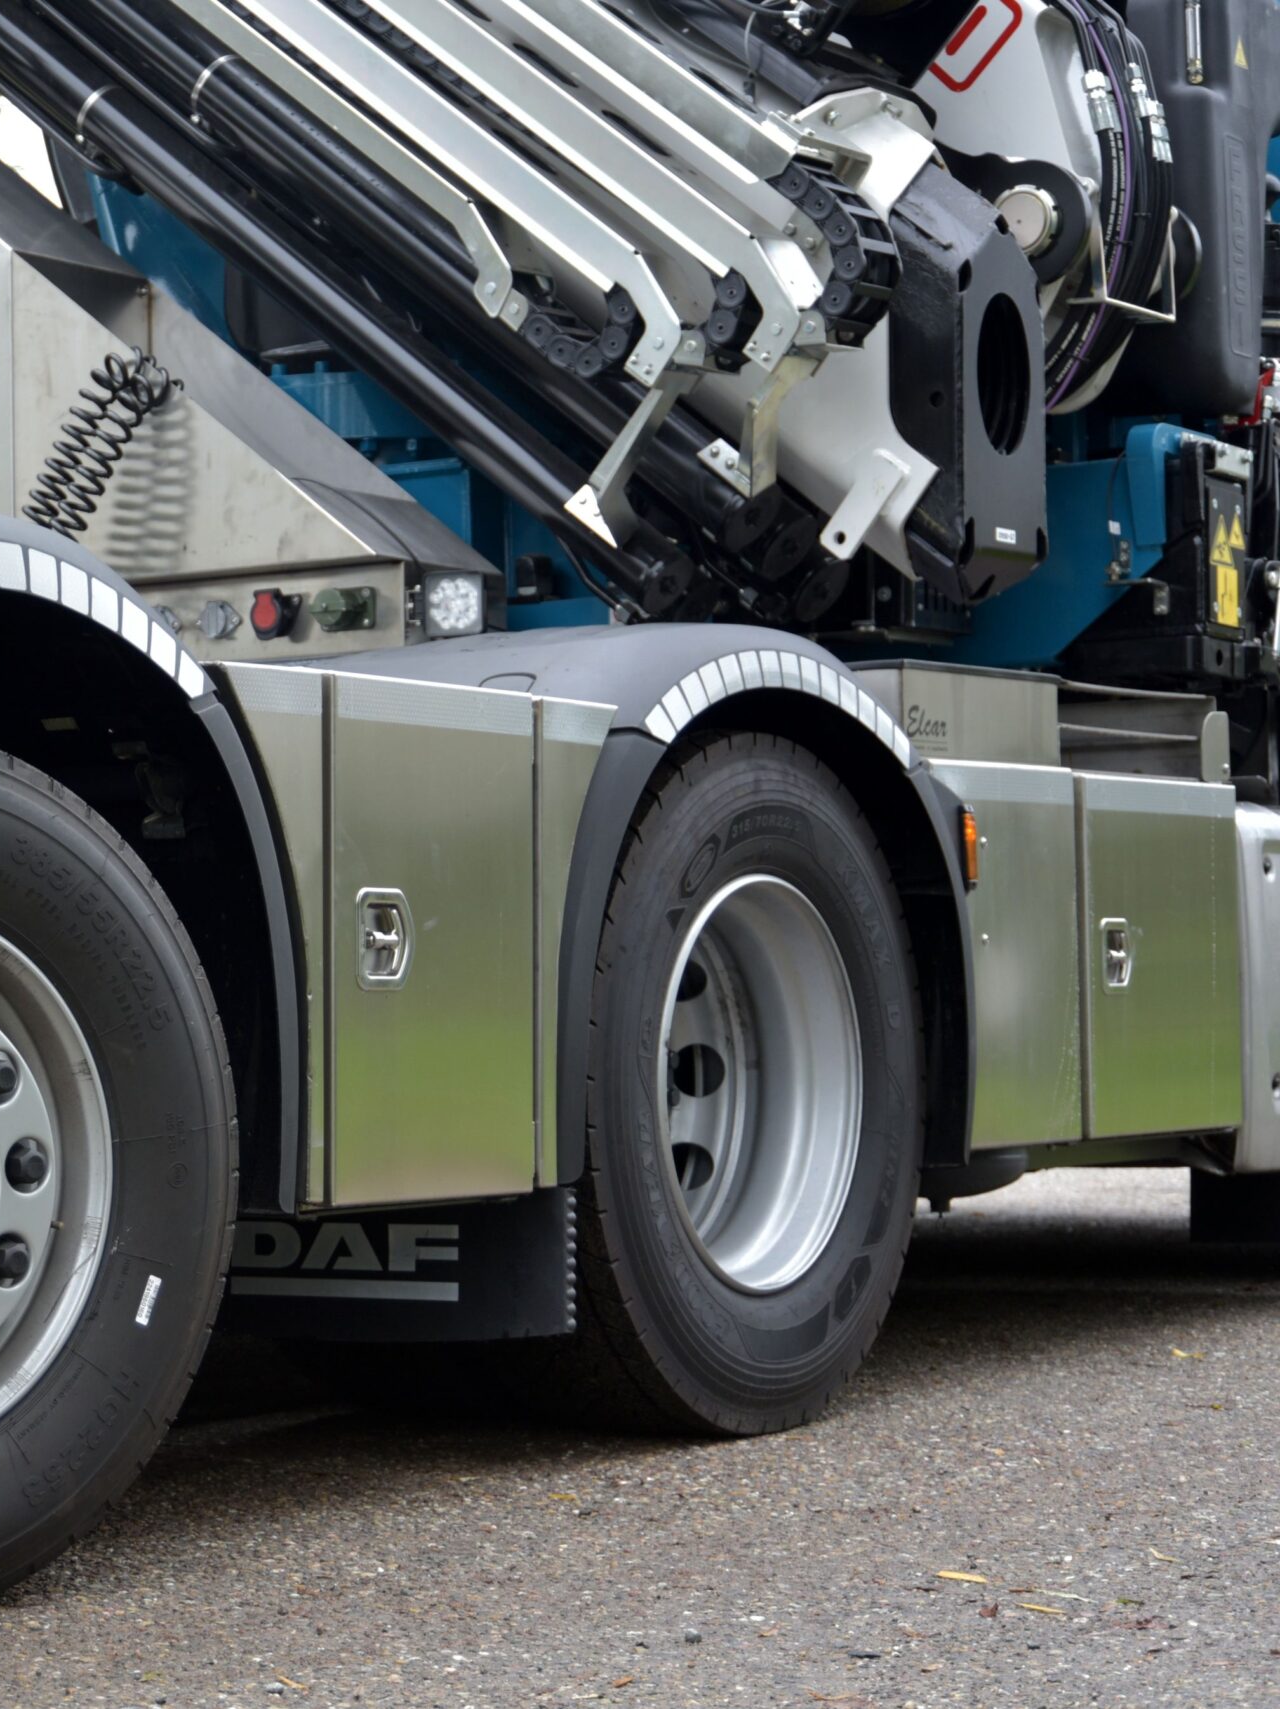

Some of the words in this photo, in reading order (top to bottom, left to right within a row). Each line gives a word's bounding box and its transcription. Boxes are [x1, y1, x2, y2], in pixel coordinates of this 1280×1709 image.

[906, 704, 948, 738] Elcar
[10, 836, 173, 1032] 385/55R22.5
[837, 853, 894, 970] KMAX
[231, 1220, 459, 1273] DAF
